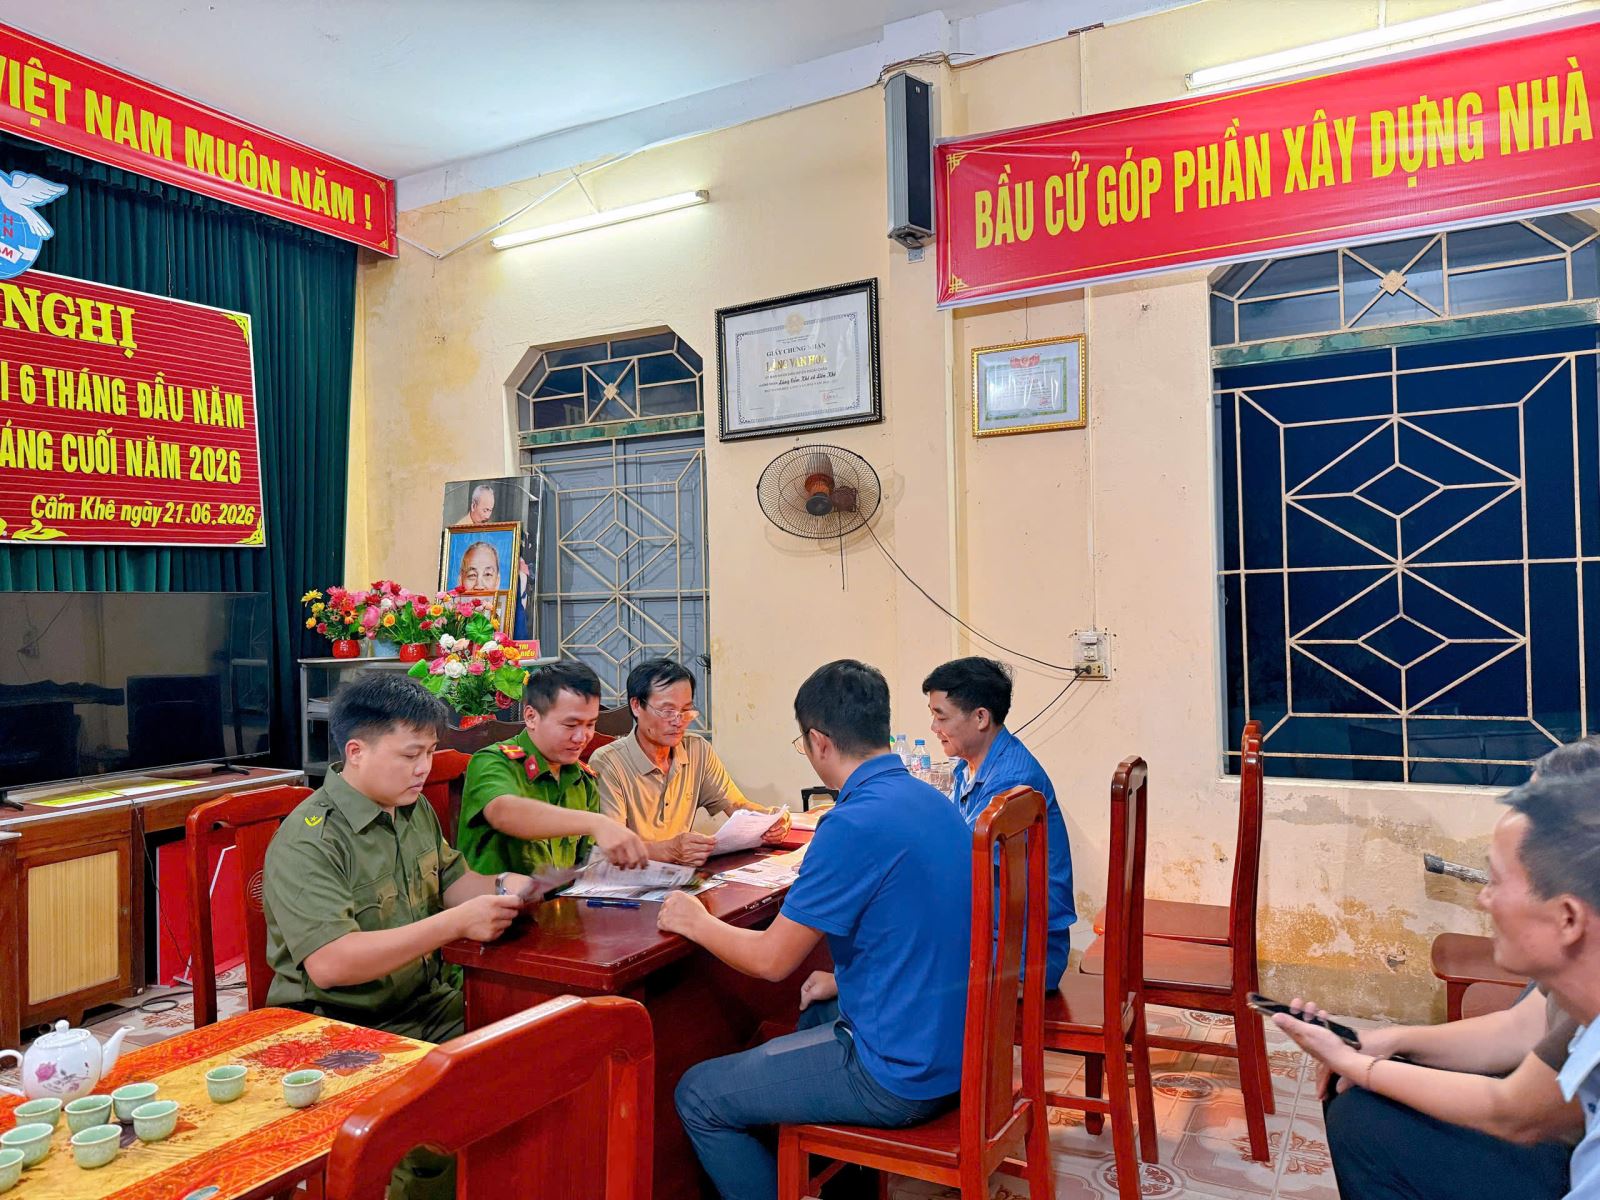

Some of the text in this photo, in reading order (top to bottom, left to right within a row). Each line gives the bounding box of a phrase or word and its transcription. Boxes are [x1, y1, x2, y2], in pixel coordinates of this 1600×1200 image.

[0, 55, 71, 128] IỆT
[85, 88, 173, 162] NAM
[184, 126, 282, 198] MUÔN
[290, 166, 356, 225] NĂM
[974, 55, 1594, 250] BẦU CỬ GÓP PHẦN XÂY DỰNG NHÀ
[0, 282, 138, 359] NGHỊ
[19, 364, 36, 404] 6
[42, 367, 127, 416] THÁNG
[137, 371, 184, 422] ĐẦU
[192, 385, 245, 429] NĂM
[0, 418, 242, 484] ÁNG CUỐI NĂM 2026
[31, 493, 256, 527] Cẩm Khê ngày 21.06.2026
